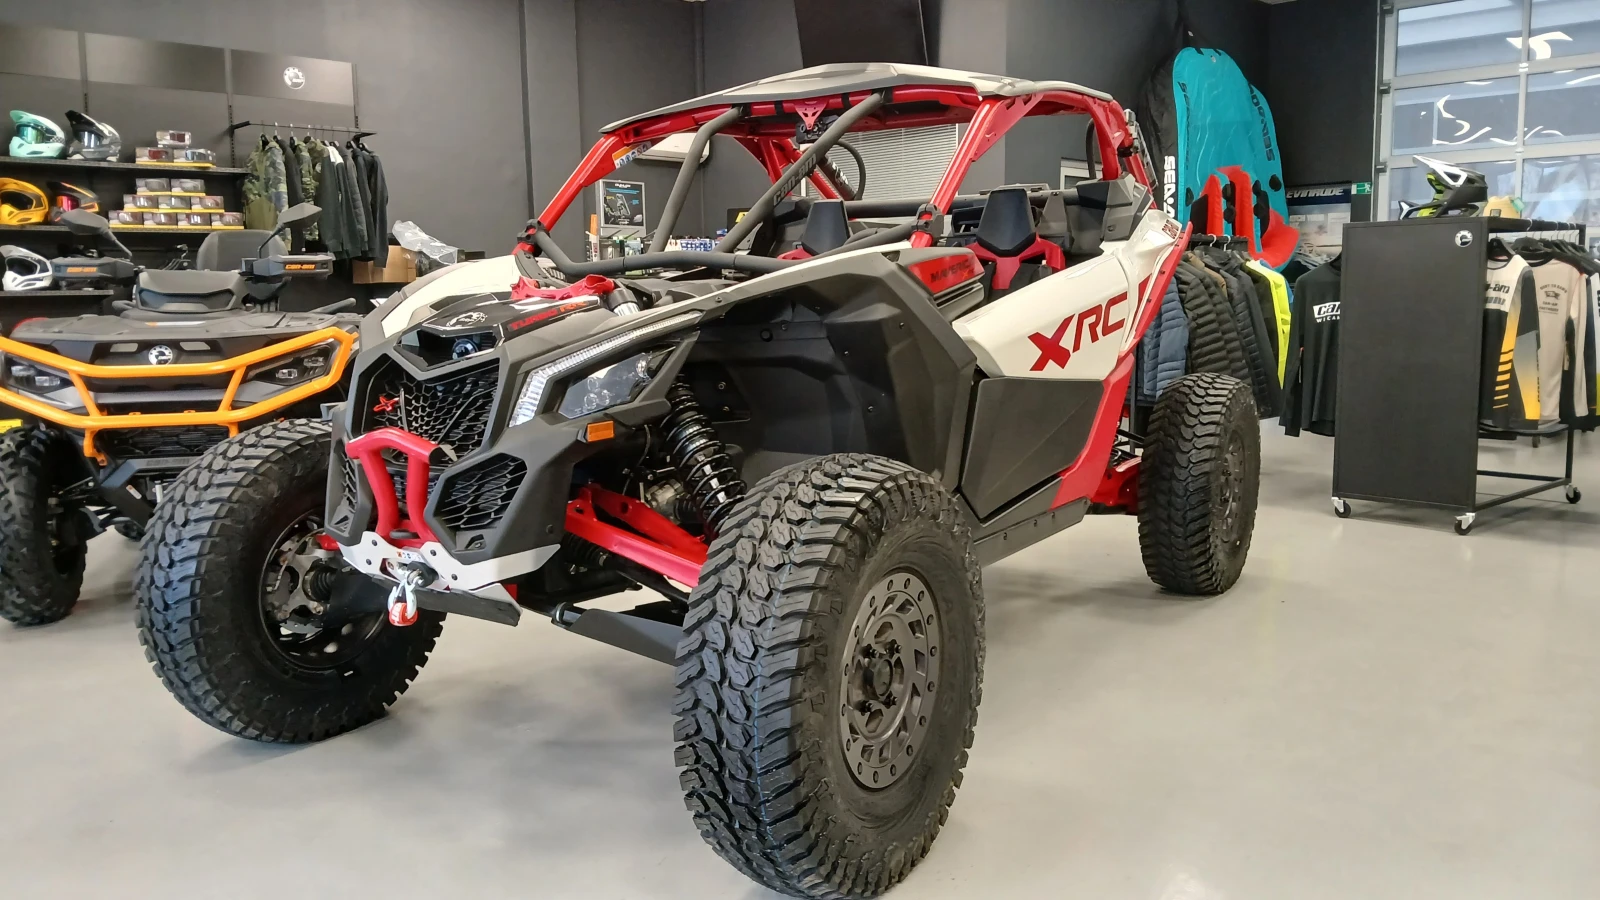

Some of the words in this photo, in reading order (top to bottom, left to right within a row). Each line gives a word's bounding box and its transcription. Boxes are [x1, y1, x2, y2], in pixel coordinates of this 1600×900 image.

[773, 153, 818, 206] can-am
[1286, 186, 1345, 199] EVINRUDE
[508, 308, 558, 331] TURBO
[1027, 291, 1128, 372] XRC
